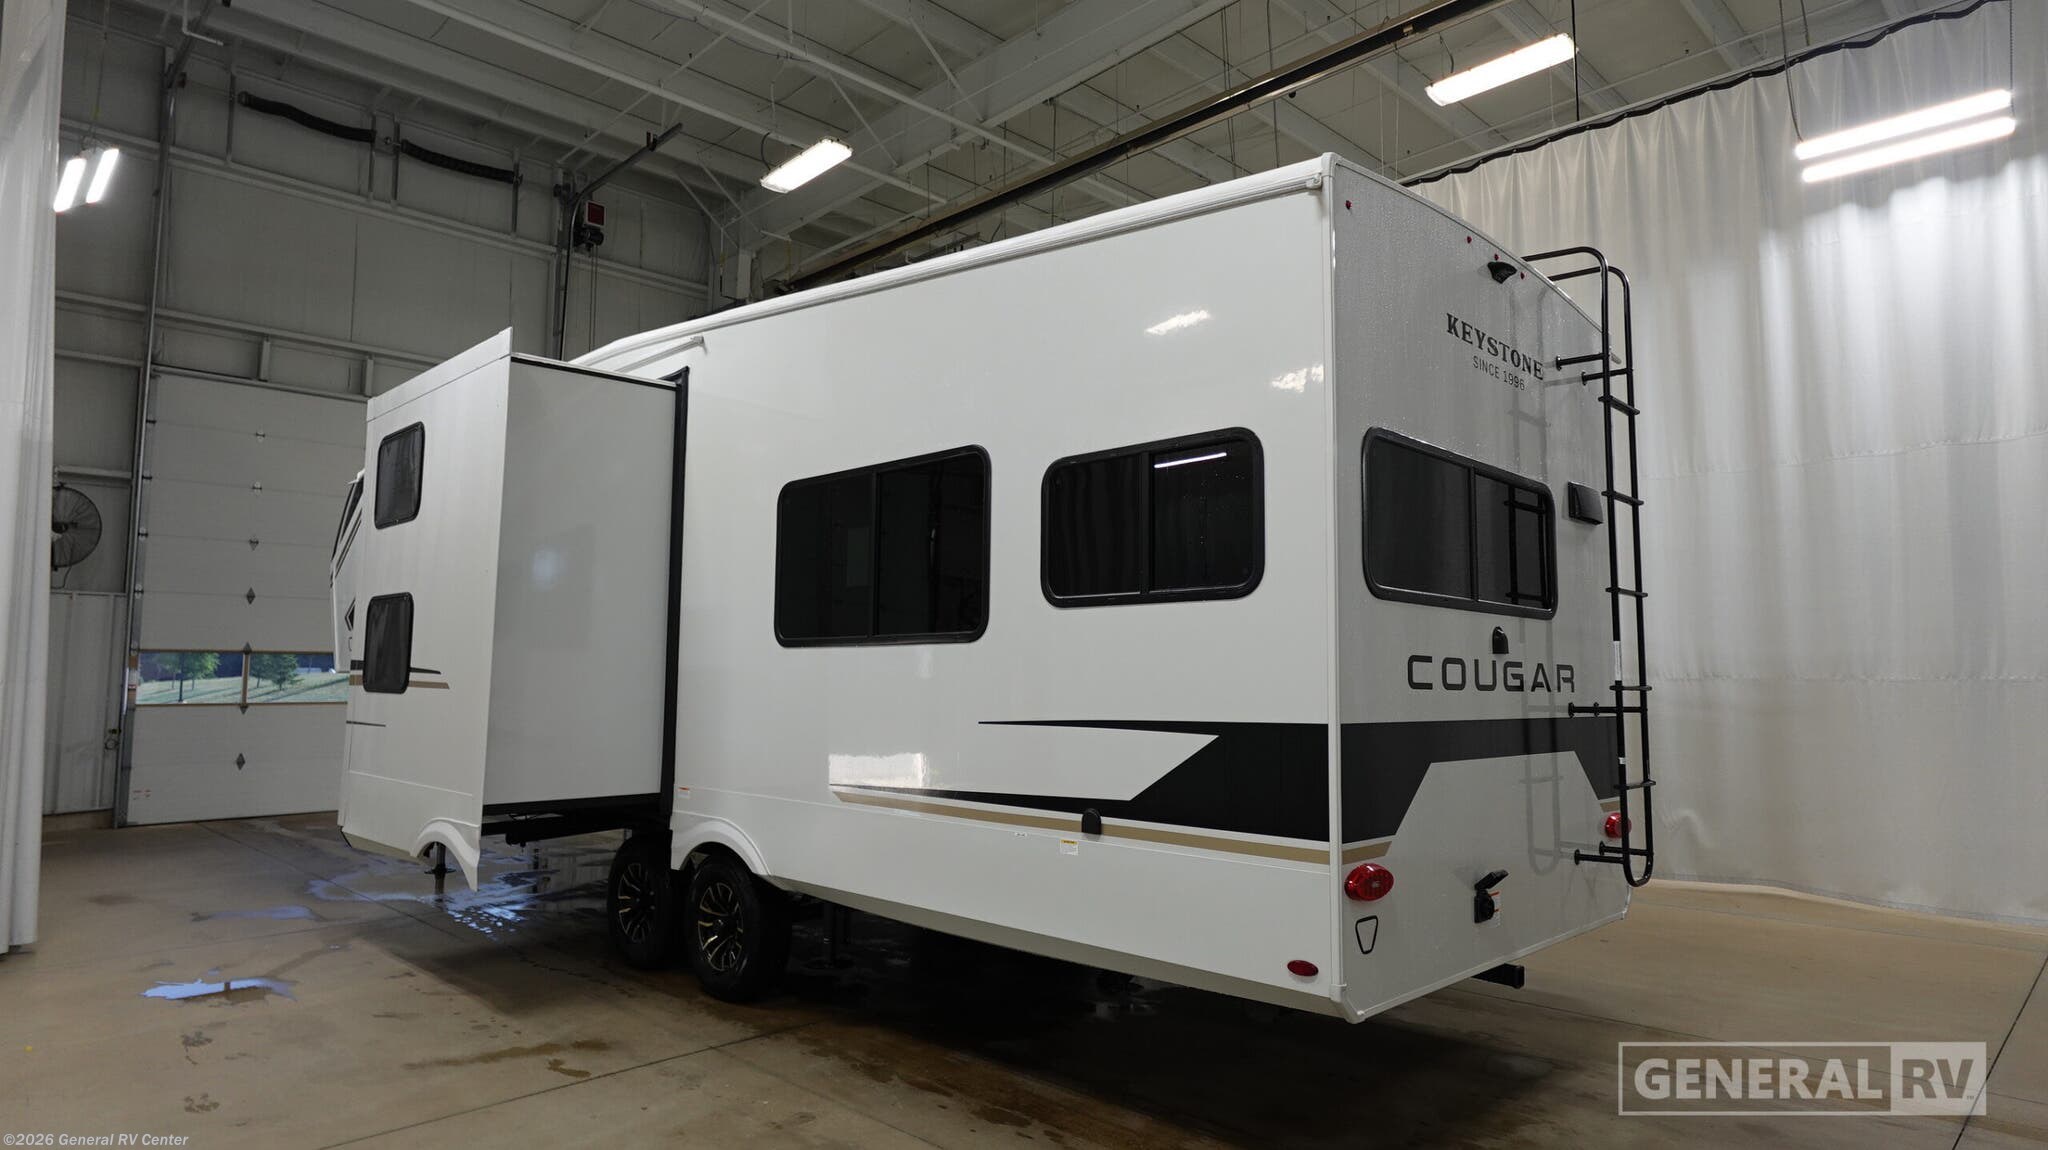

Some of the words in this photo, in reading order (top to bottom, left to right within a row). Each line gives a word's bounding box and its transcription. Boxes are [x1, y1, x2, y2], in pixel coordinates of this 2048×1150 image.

[1446, 312, 1544, 381] KEYSTONE
[1472, 355, 1500, 380] SINCE
[1503, 370, 1525, 391] 1996
[1407, 654, 1575, 693] COUGAR
